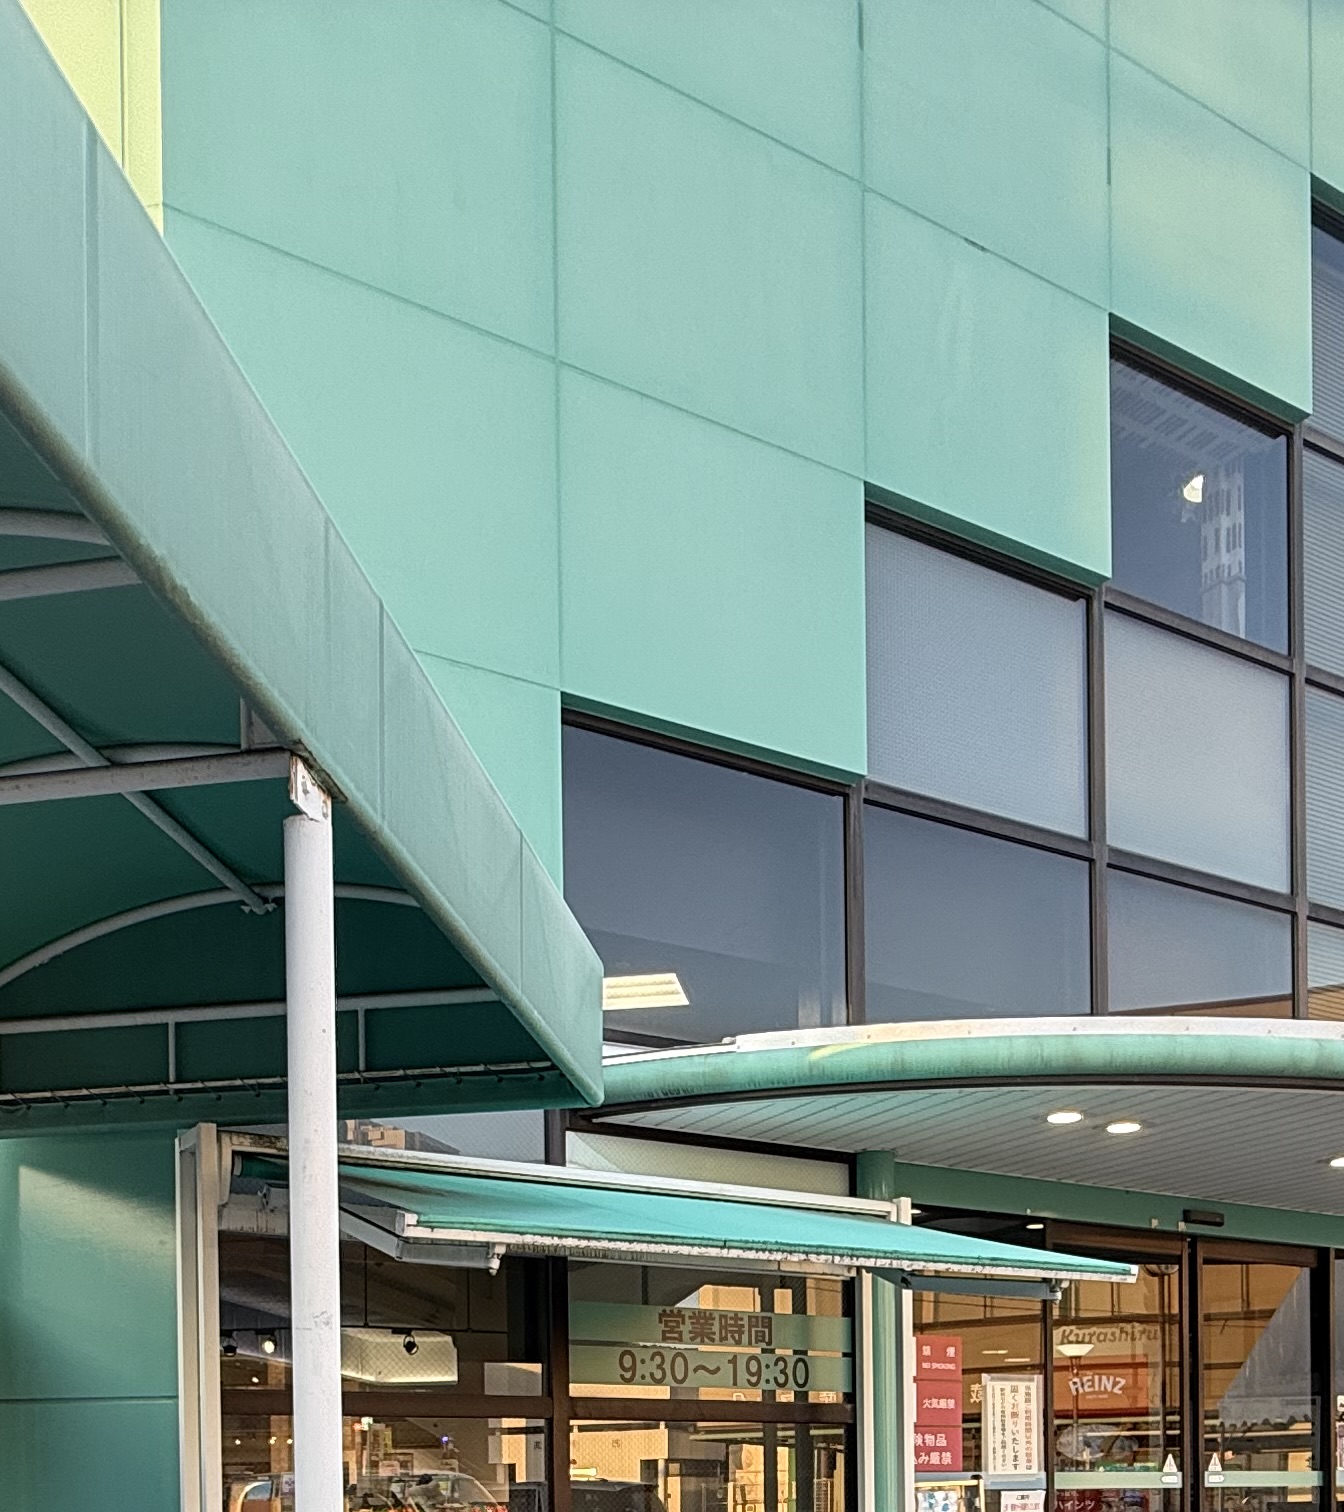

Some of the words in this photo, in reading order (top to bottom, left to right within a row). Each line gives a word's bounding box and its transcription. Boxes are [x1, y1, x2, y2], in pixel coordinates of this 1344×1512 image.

[658, 1309, 773, 1347] 営業時間
[913, 1433, 948, 1447] 険物品
